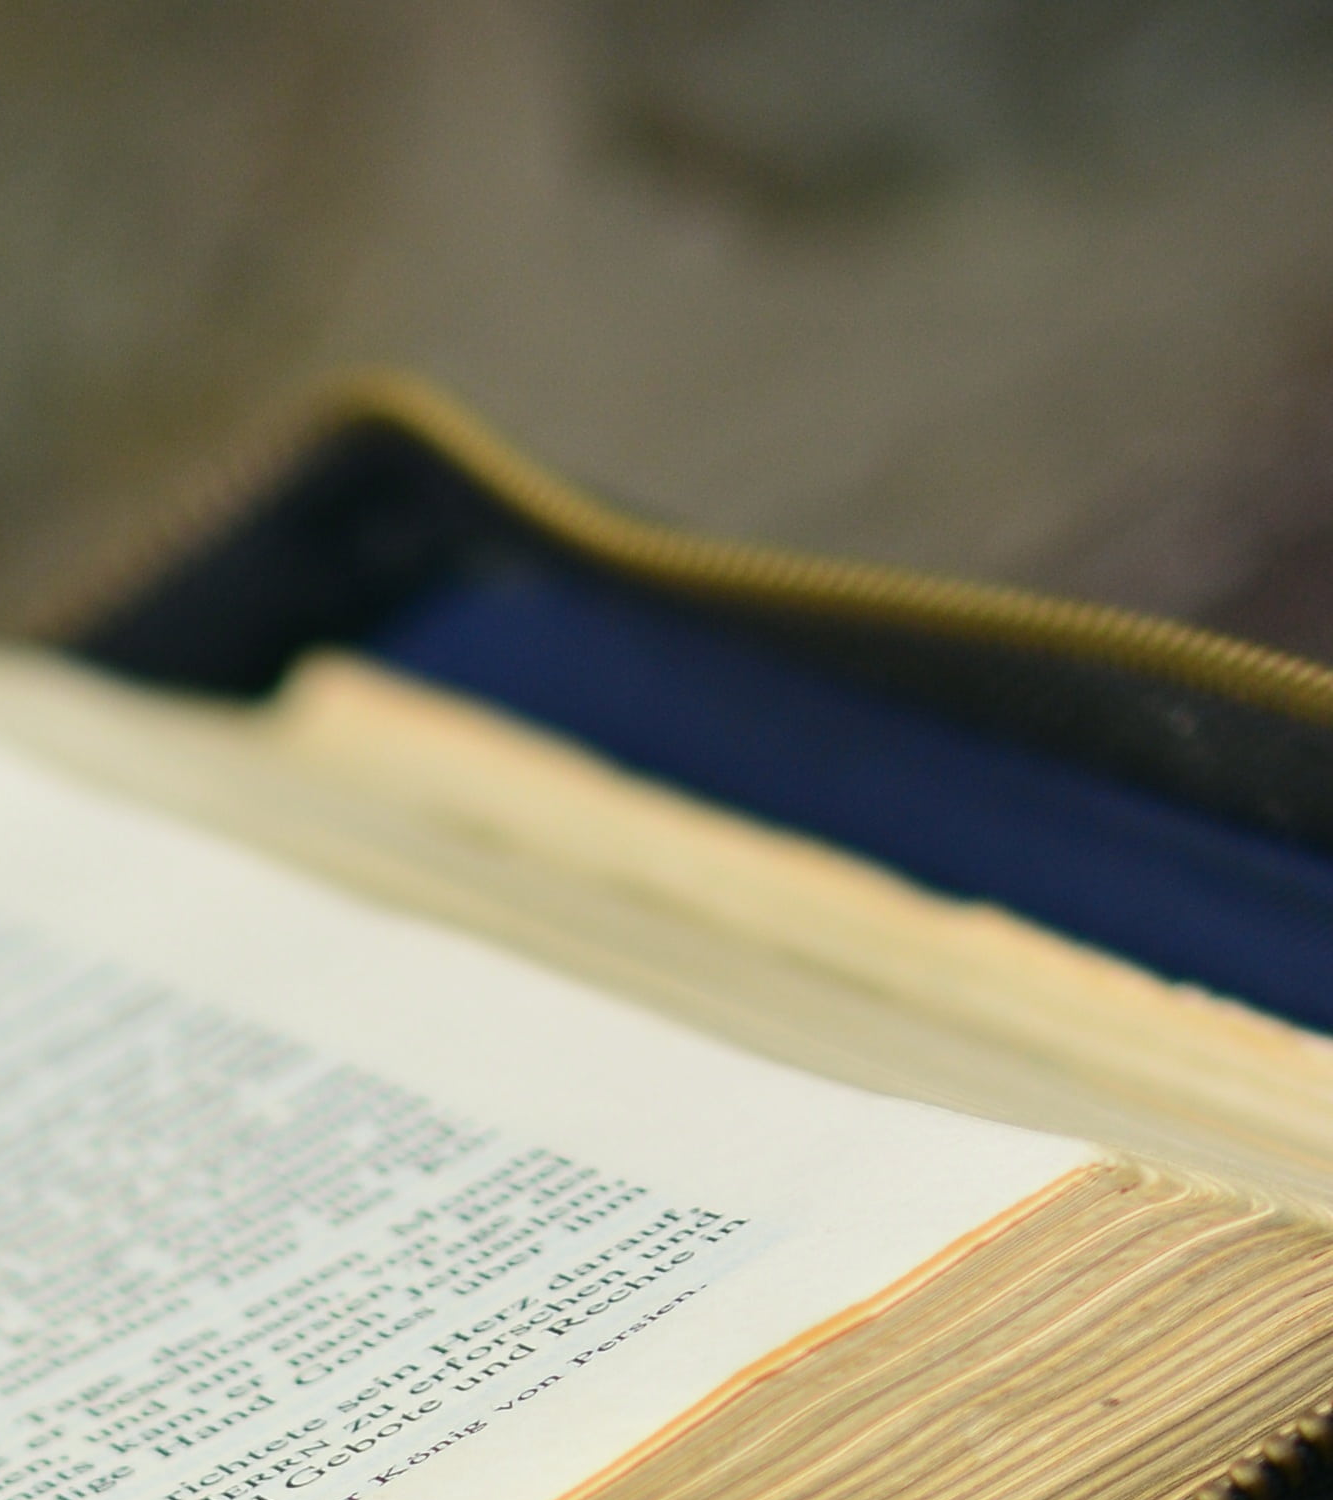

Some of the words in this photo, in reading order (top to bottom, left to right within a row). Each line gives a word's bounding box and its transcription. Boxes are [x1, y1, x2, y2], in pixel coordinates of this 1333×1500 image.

[284, 1398, 444, 1490] Gebote
[451, 1342, 537, 1393] und
[544, 1250, 696, 1338] Rechte
[704, 1218, 749, 1244] in
[335, 1363, 421, 1414] sein
[428, 1294, 540, 1356] Herz
[343, 1402, 396, 1436] zu
[407, 1269, 628, 1396] erforschen
[639, 1210, 724, 1261] und
[370, 1418, 489, 1487] König
[493, 1374, 564, 1413] von
[569, 1283, 709, 1367] Persien.
